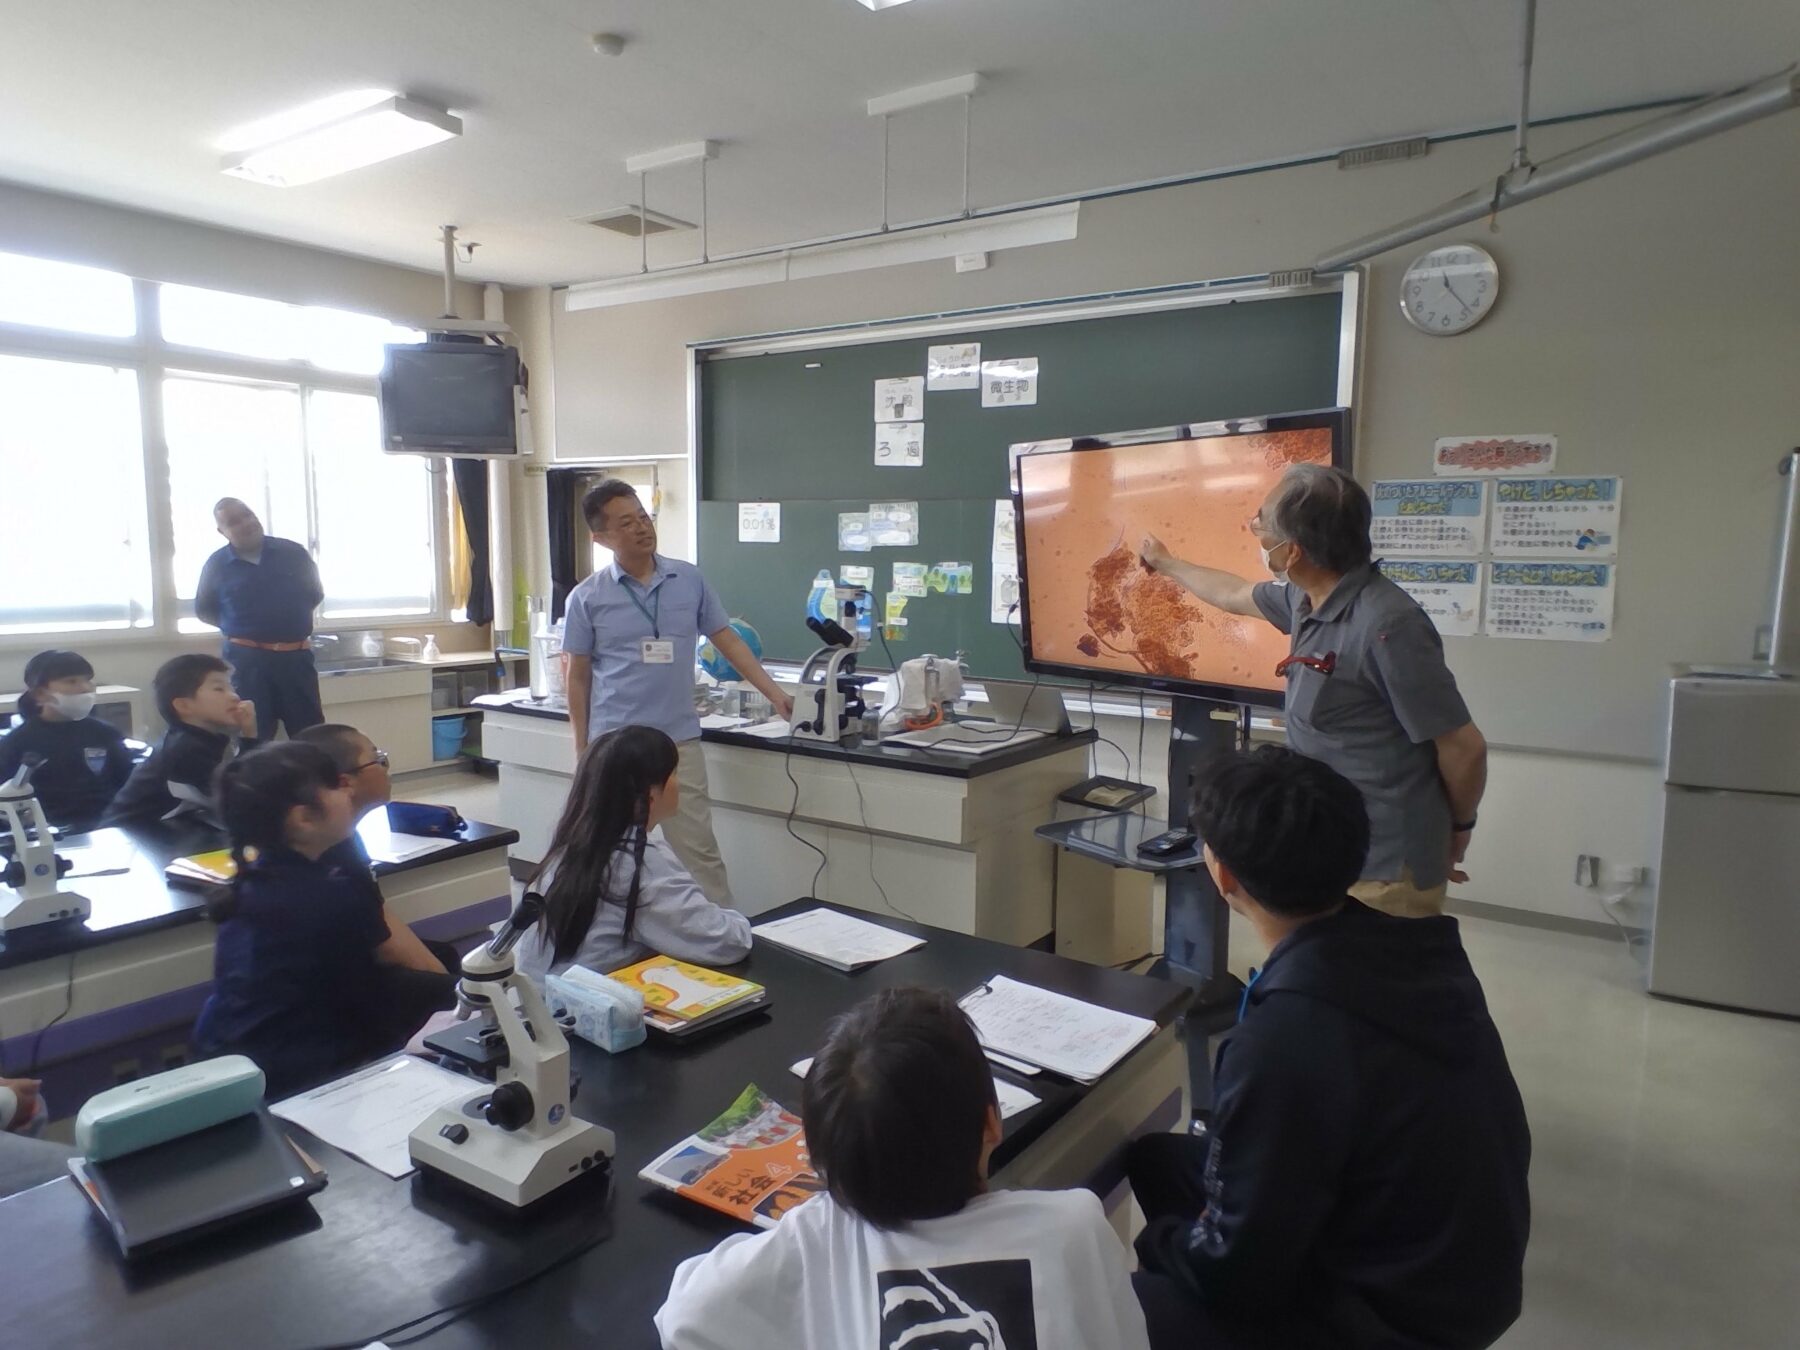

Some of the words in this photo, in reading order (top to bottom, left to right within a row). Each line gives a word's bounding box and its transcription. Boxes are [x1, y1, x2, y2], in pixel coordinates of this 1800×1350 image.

[1446, 252, 1458, 264] 12
[1412, 286, 1421, 296] 9
[1478, 280, 1487, 293] 3
[1415, 301, 1424, 312] 8
[1471, 297, 1480, 307] 4
[1428, 311, 1436, 322] 7
[1441, 314, 1450, 327] 6
[1459, 309, 1468, 321] 5
[729, 1175, 776, 1205] 社会
